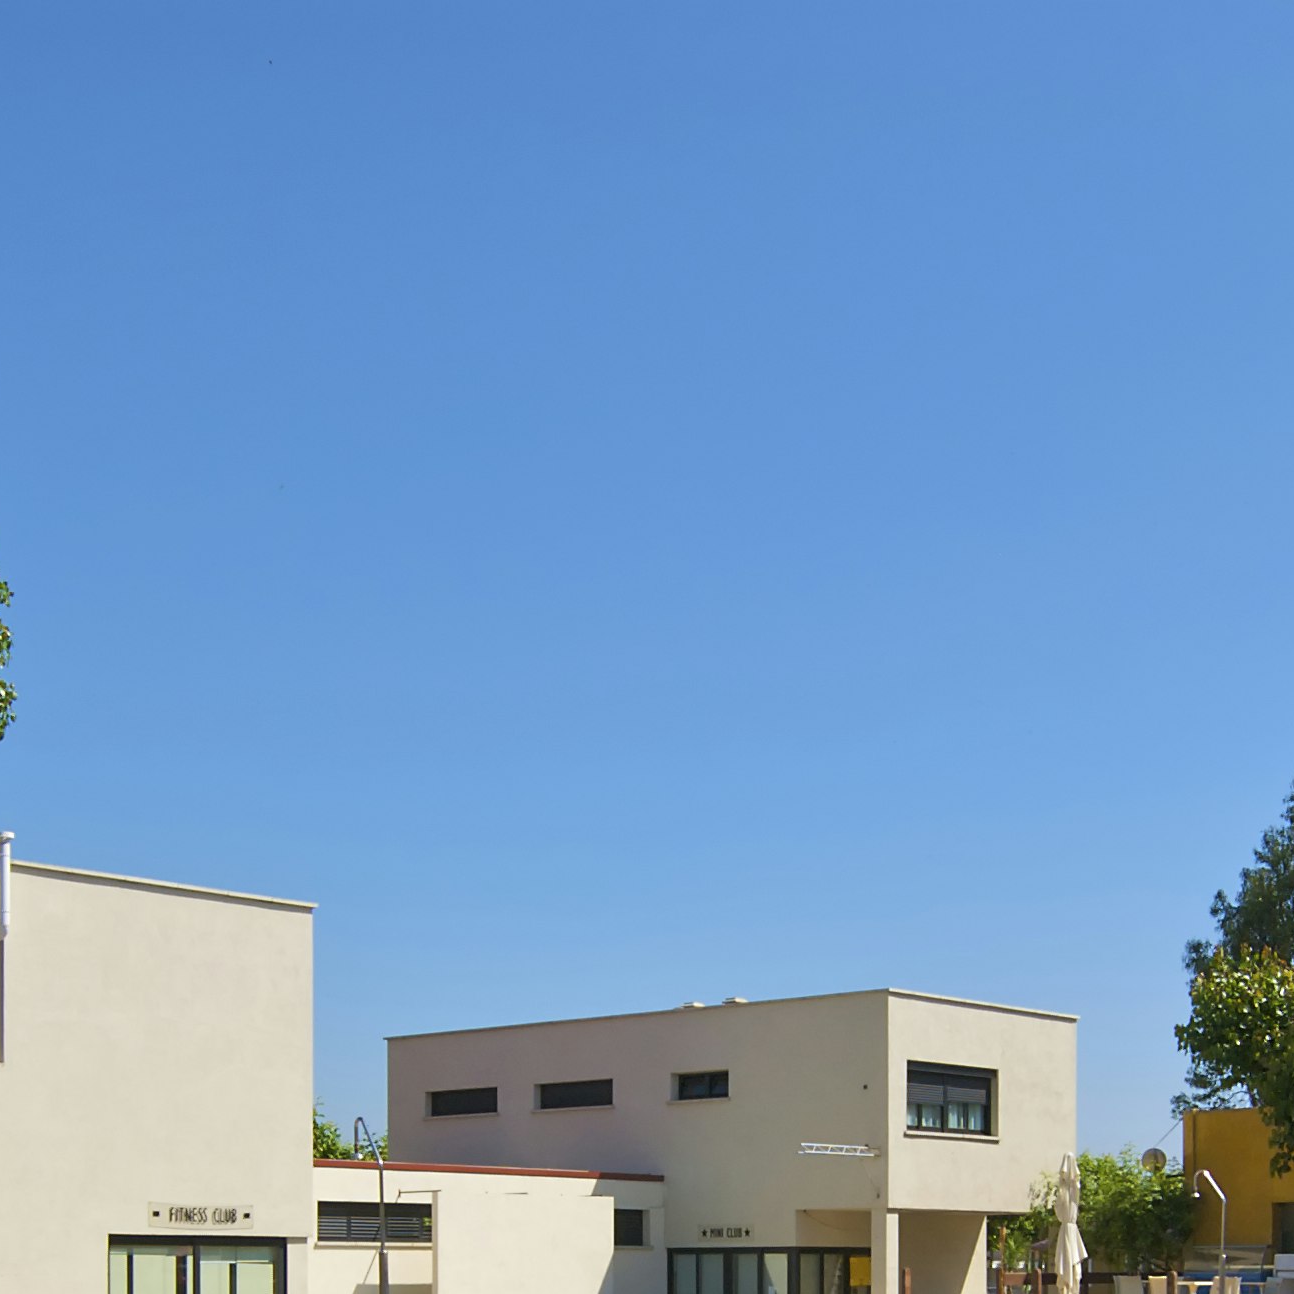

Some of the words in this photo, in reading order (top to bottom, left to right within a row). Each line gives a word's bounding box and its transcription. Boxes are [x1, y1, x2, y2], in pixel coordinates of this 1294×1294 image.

[169, 1206, 208, 1224] FITNESS
[212, 1207, 238, 1225] CLUB
[726, 1227, 743, 1238] CLUB
